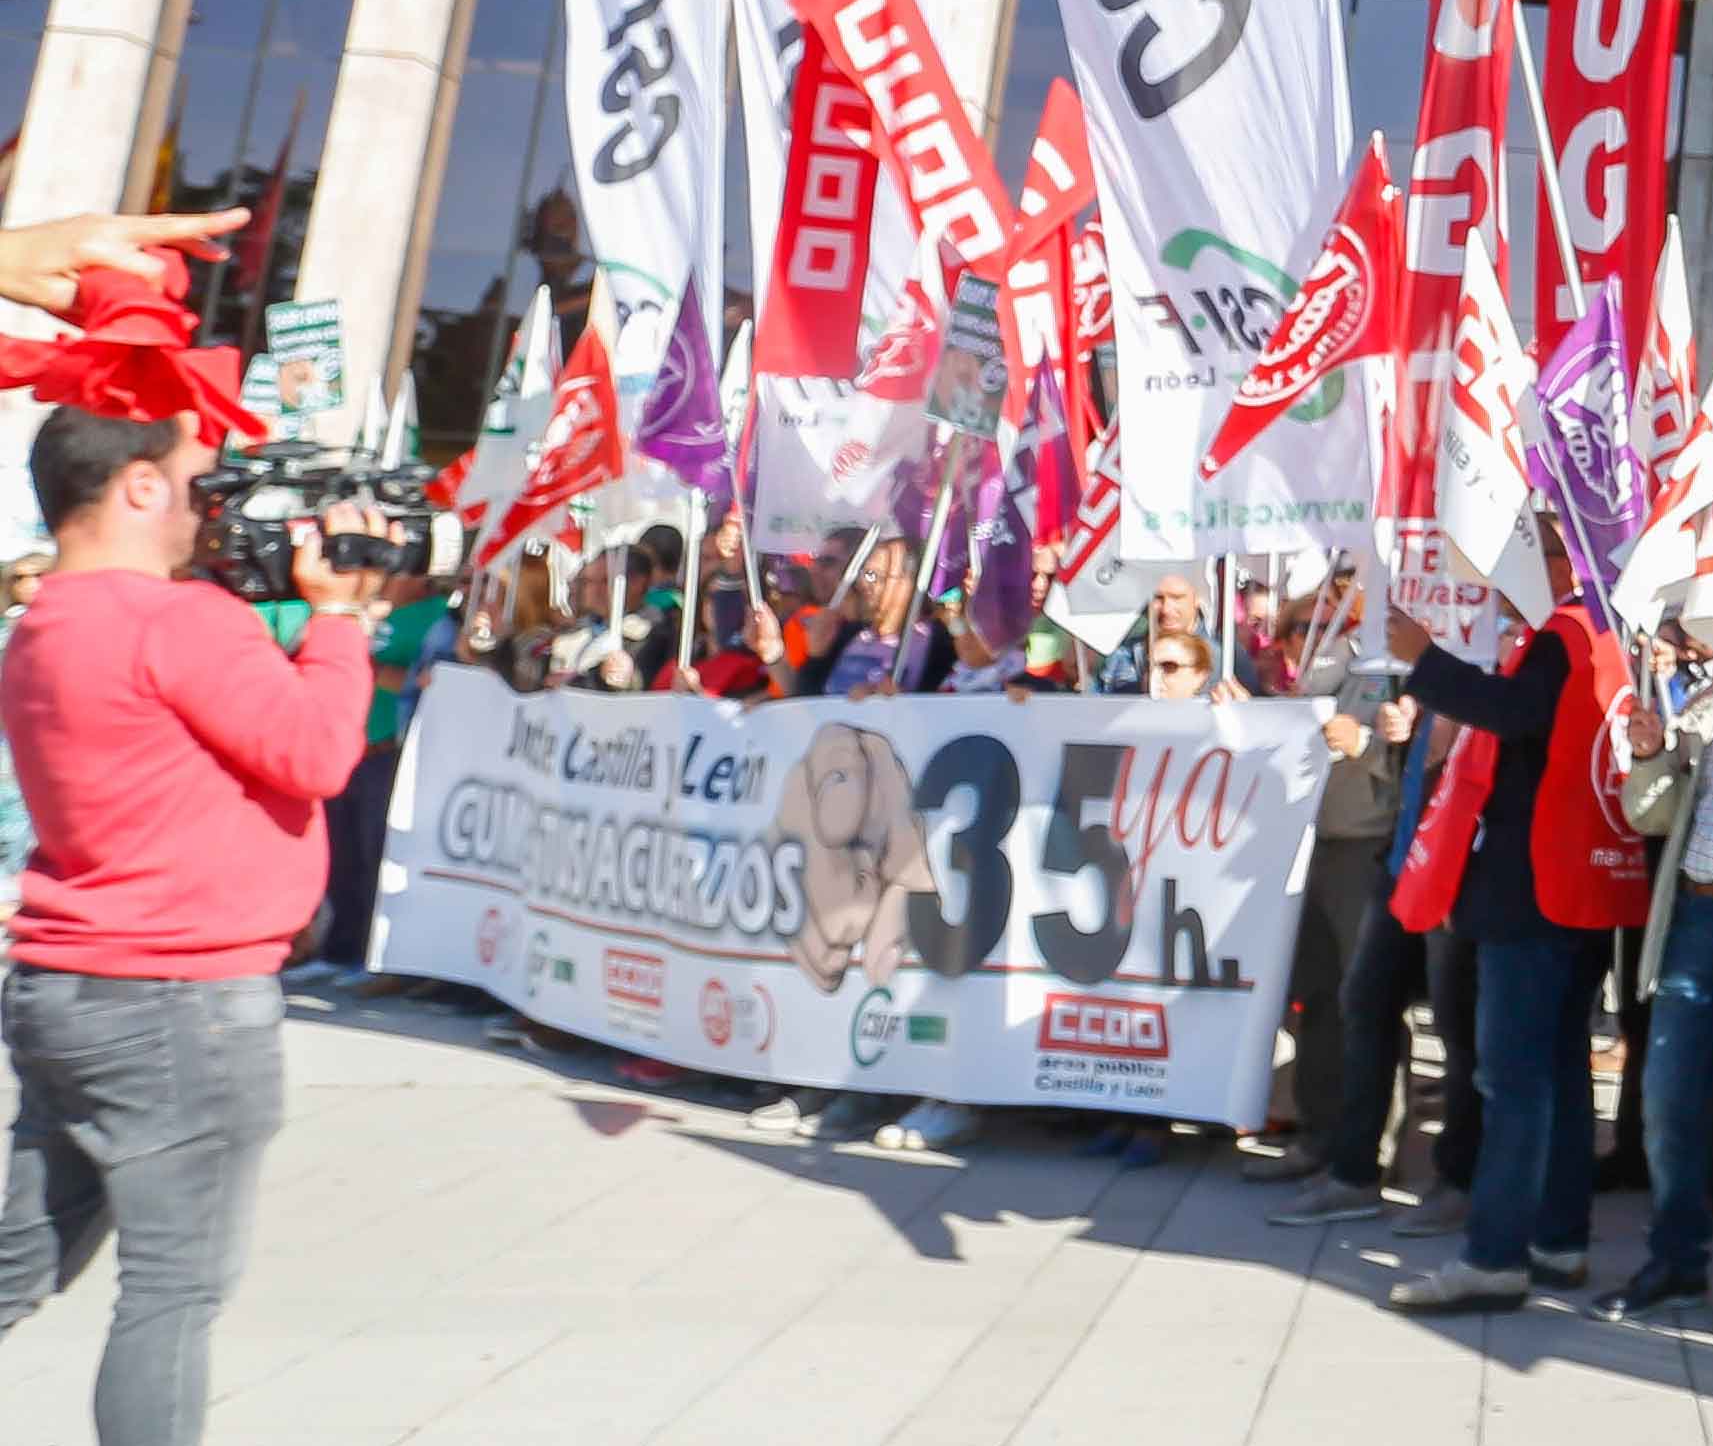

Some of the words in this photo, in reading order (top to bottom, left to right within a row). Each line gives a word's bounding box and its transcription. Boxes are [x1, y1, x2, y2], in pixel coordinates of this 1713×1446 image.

[906, 735, 1134, 984] 35
[1109, 746, 1261, 926] ya
[1050, 1005, 1161, 1049] CCOO
